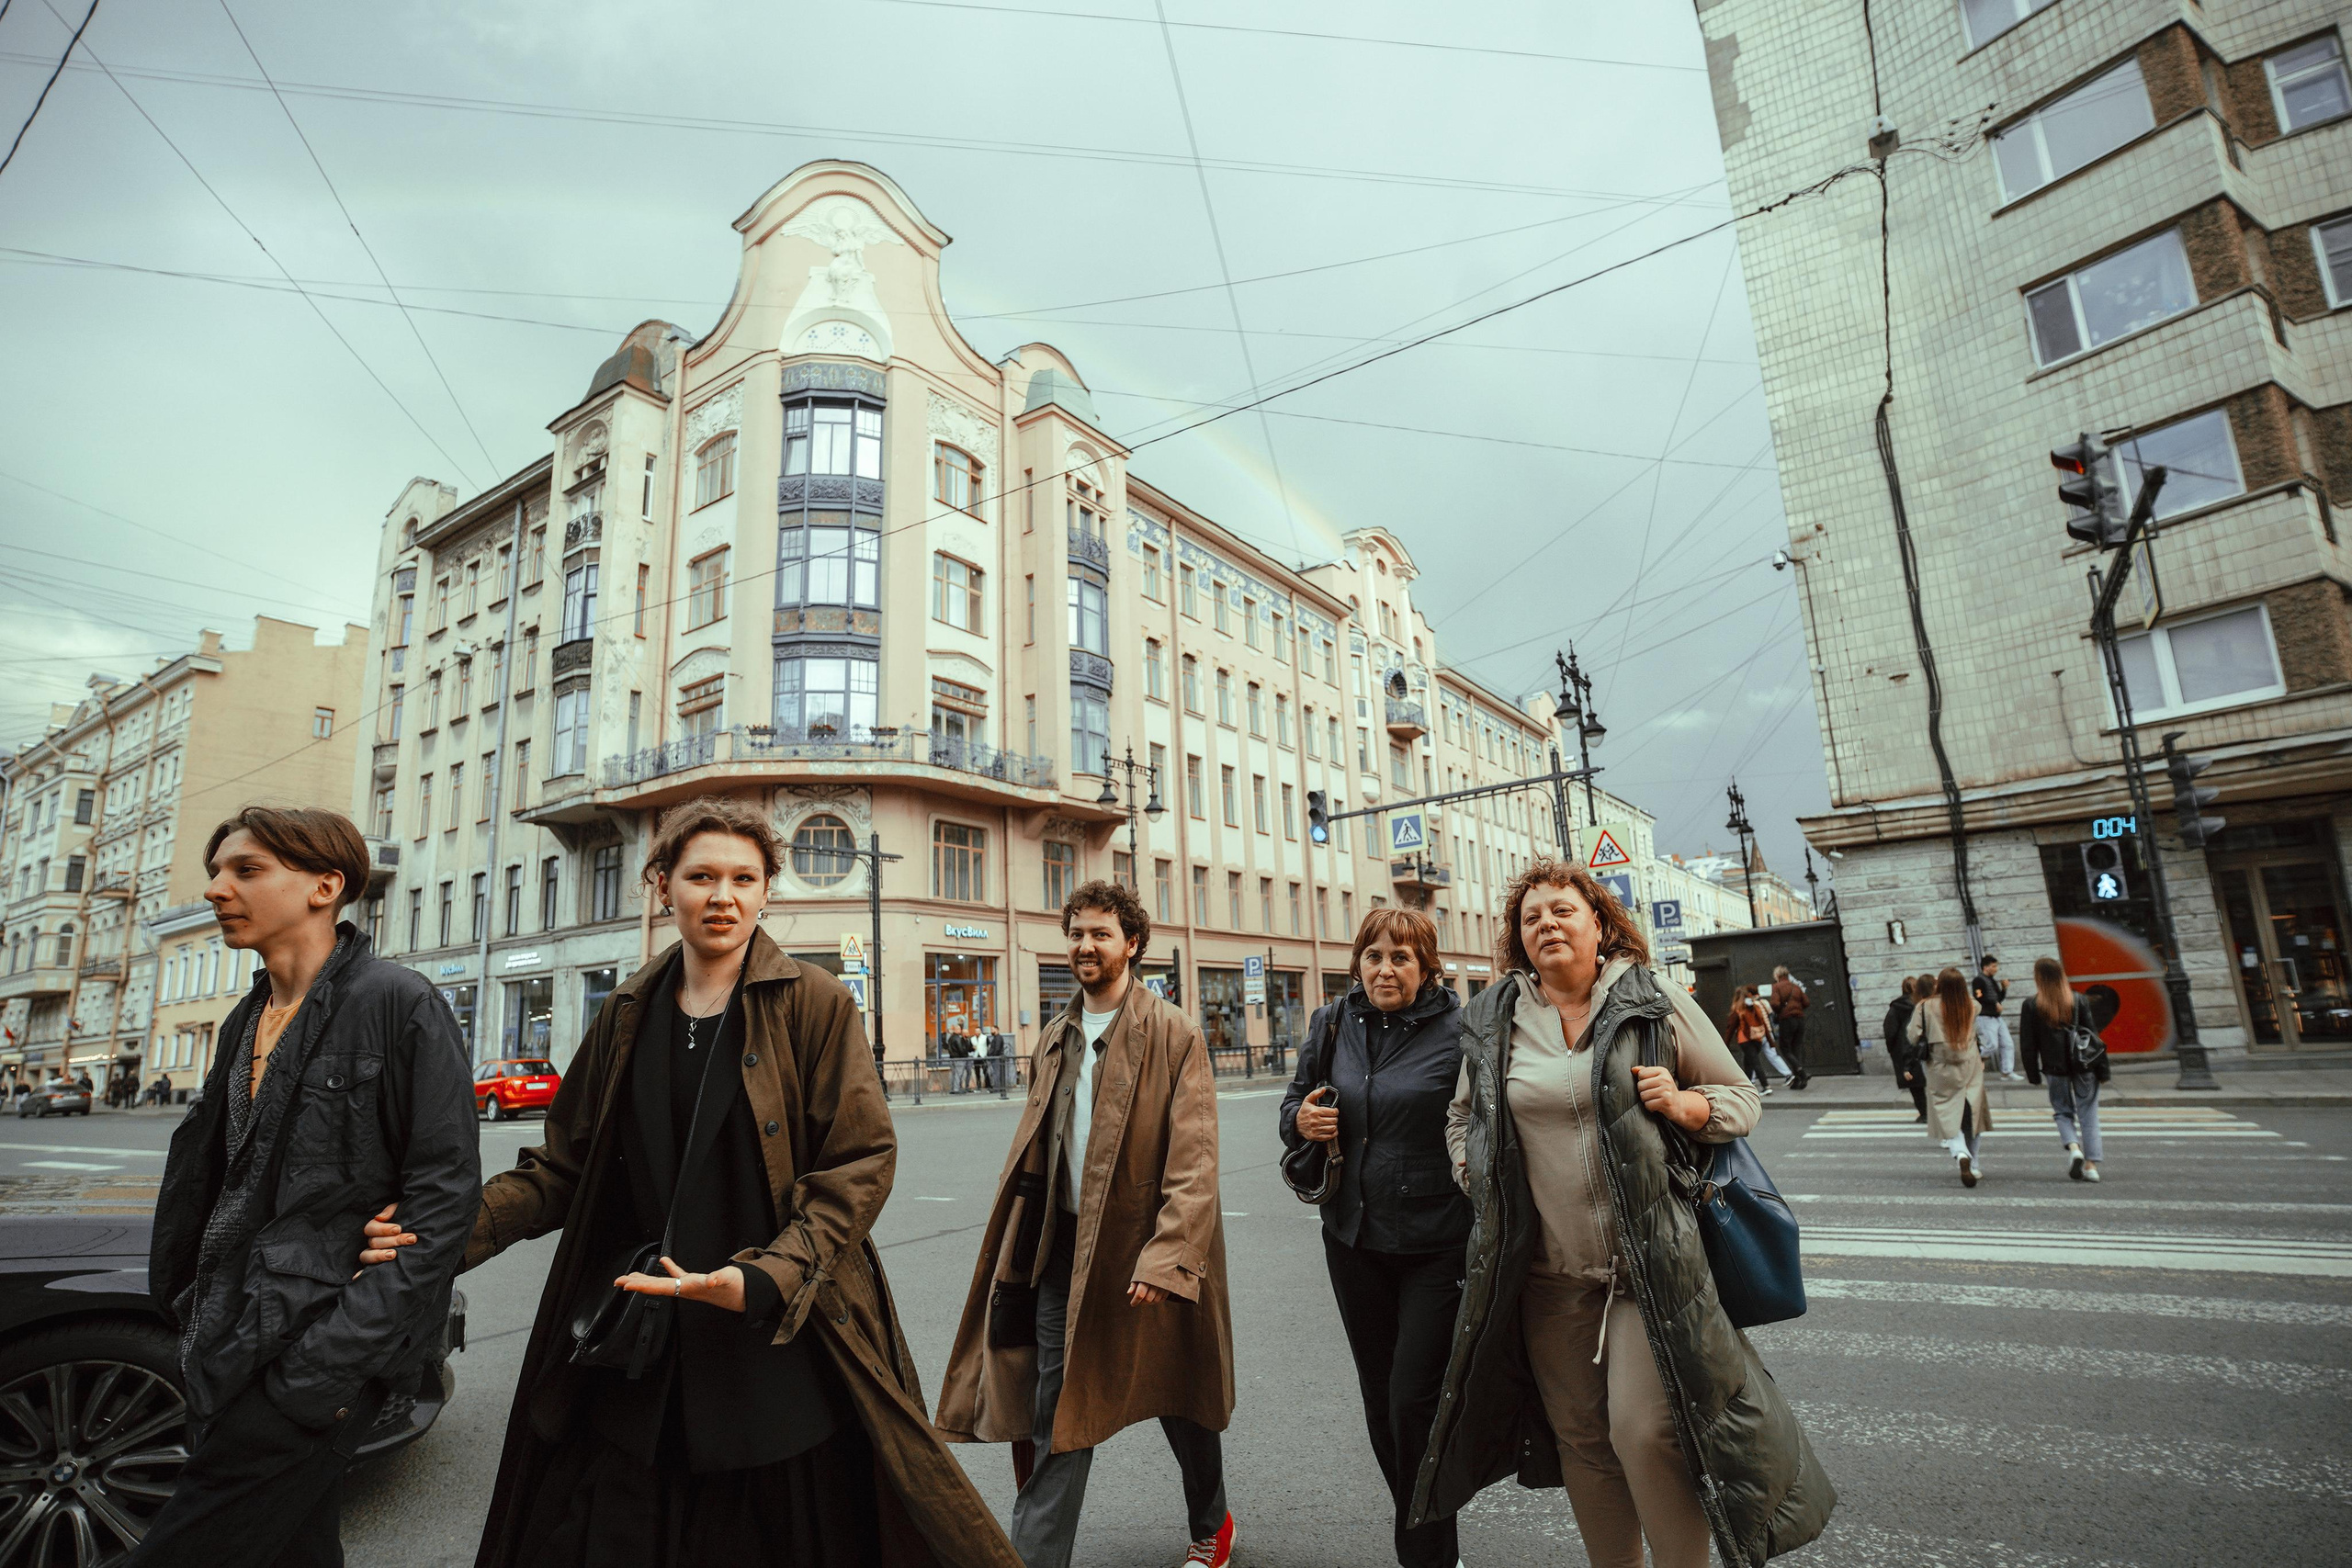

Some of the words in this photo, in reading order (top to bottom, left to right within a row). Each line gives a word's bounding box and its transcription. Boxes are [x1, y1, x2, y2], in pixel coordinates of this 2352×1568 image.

[2093, 817, 2136, 839] 004
[1659, 903, 1676, 926] P
[945, 924, 989, 938] ВкусВилл
[1249, 958, 1260, 975] P
